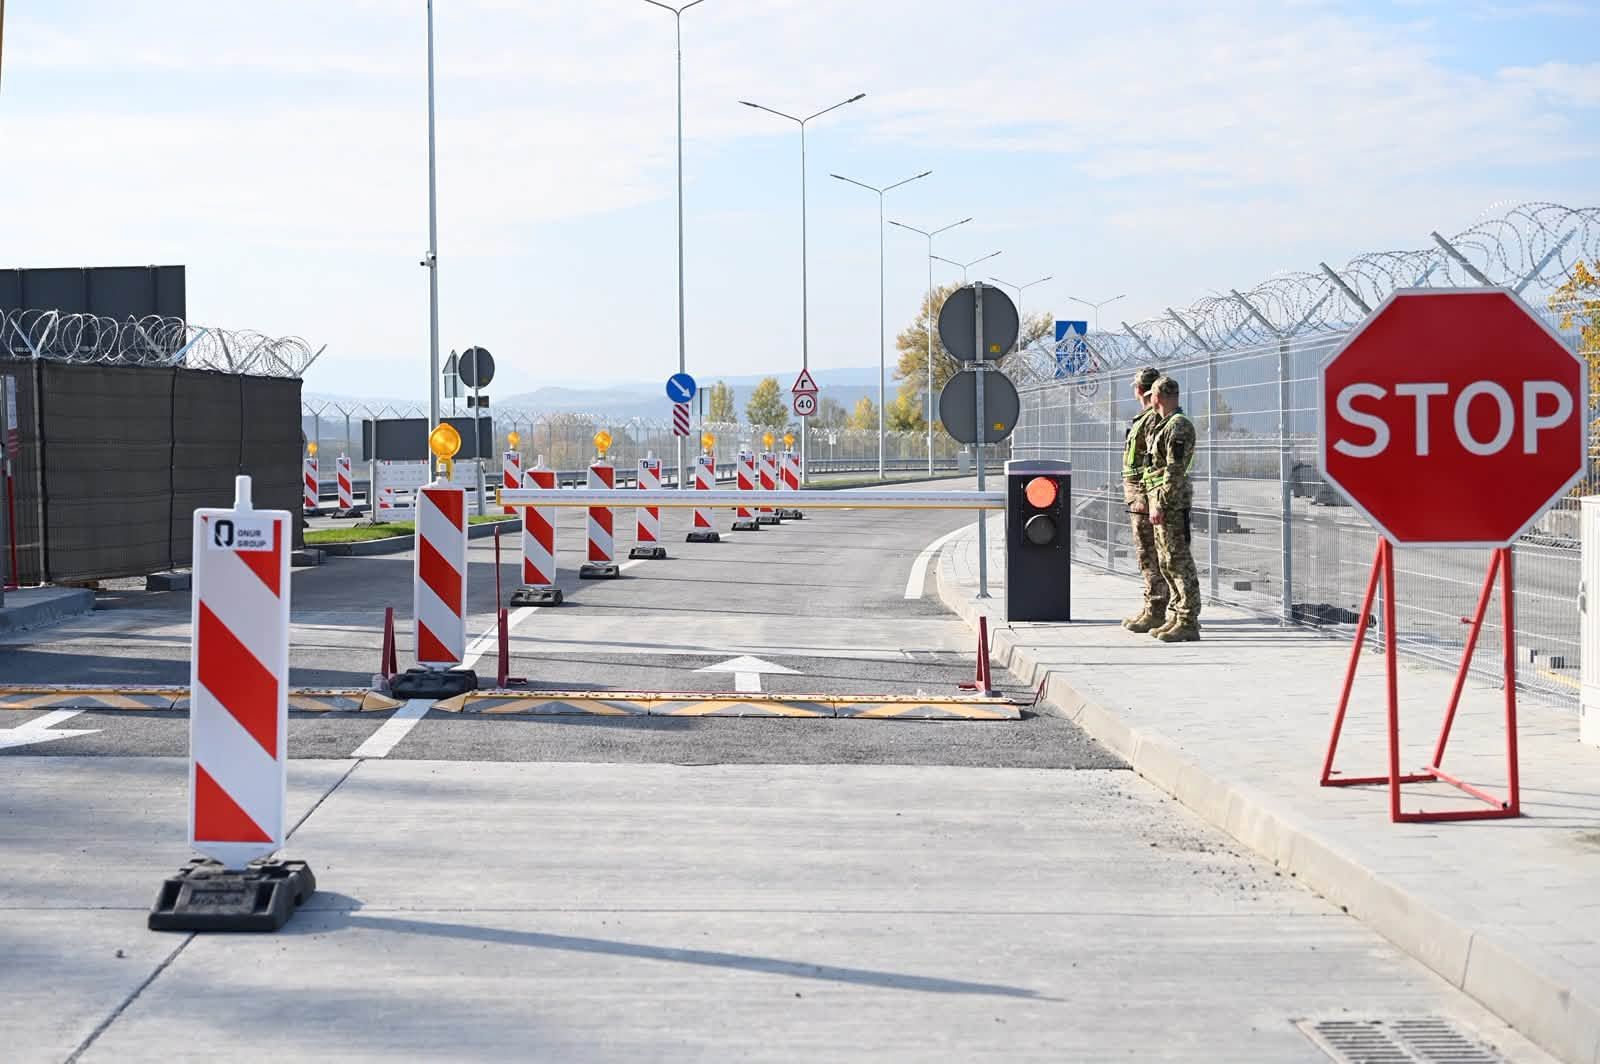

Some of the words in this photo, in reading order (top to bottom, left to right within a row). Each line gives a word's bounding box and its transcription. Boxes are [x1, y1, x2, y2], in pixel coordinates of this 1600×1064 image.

[798, 399, 812, 409] 40
[1333, 380, 1574, 458] STOP
[237, 529, 261, 537] ONUR
[237, 540, 267, 548] GROUP
